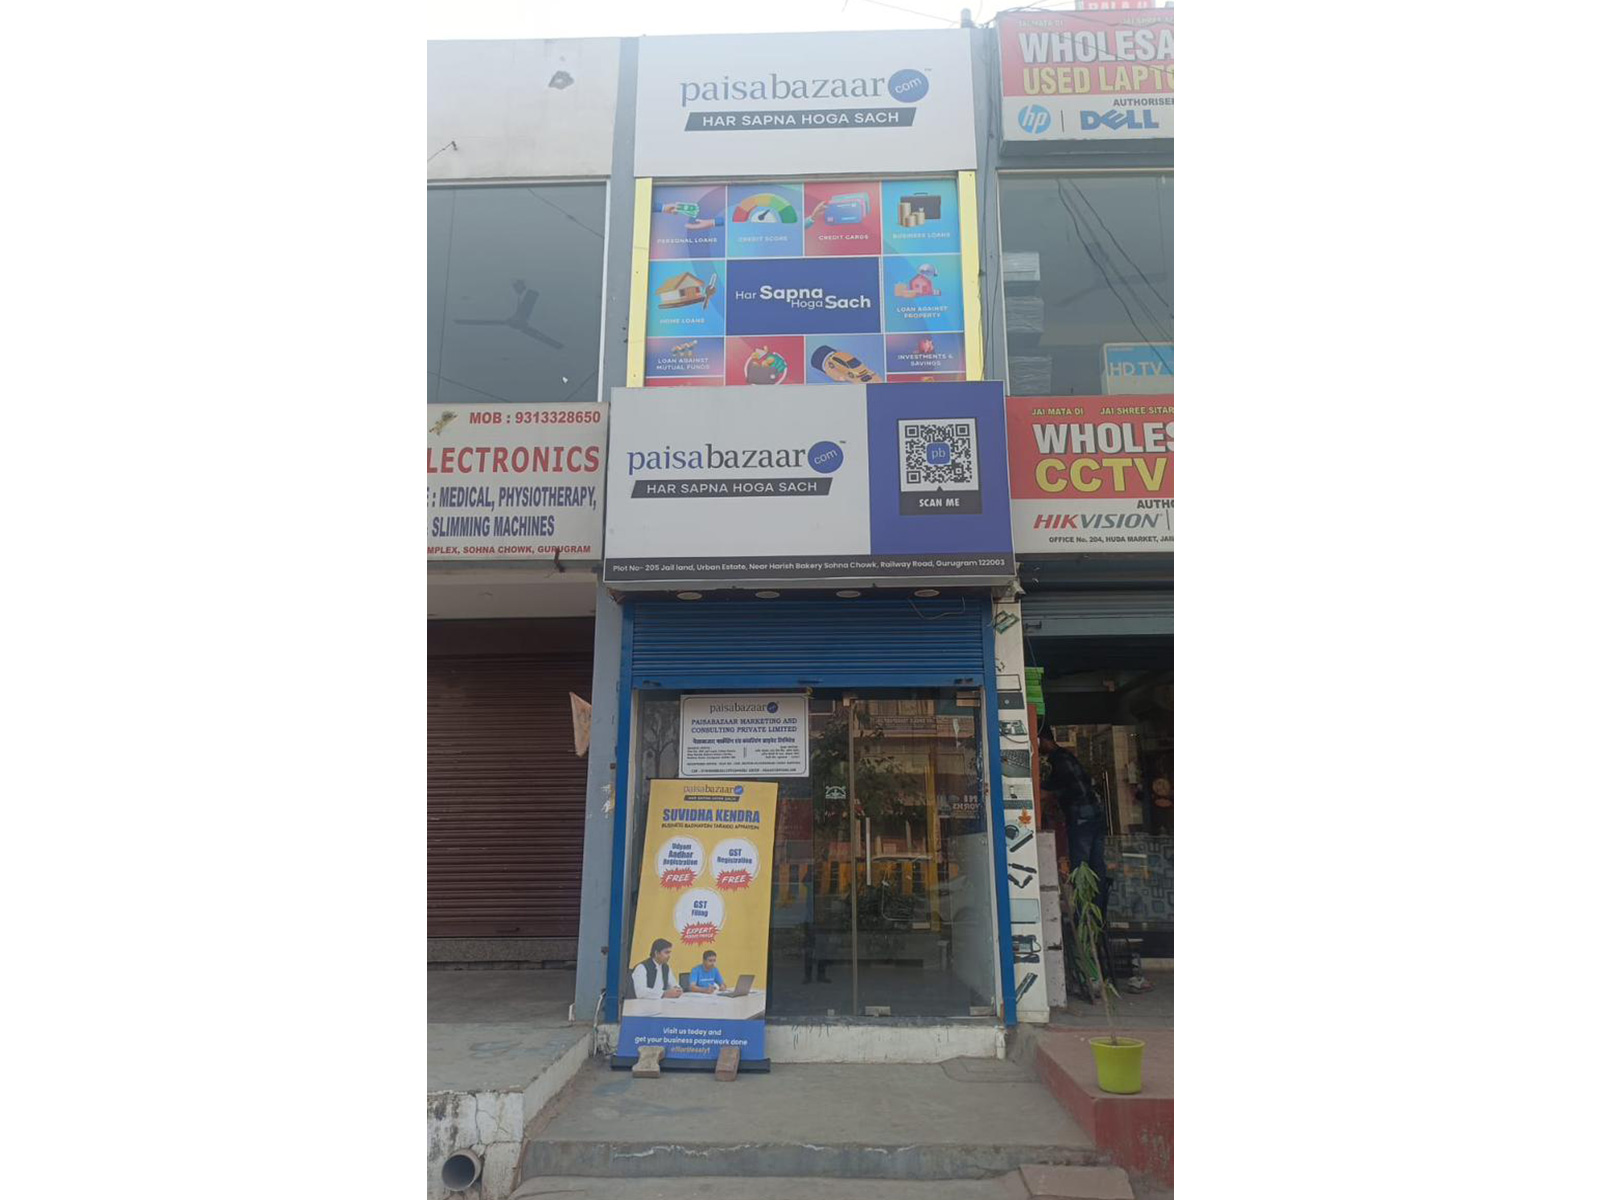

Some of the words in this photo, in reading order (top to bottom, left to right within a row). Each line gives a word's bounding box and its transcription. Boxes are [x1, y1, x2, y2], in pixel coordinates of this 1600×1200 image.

[894, 76, 922, 95] com
[1023, 66, 1090, 94] USED
[680, 73, 885, 107] paisabazaar
[703, 115, 736, 127] HAR
[741, 114, 796, 126] SAPNA
[802, 113, 849, 125] HOGA
[854, 112, 899, 124] SACH
[1022, 105, 1047, 133] hp
[1080, 109, 1159, 130] DELL
[735, 291, 757, 300] Har
[760, 285, 823, 302] Sapna
[791, 300, 823, 310] Hoga
[824, 295, 871, 310] Sach
[1110, 362, 1134, 376] HD
[1139, 361, 1162, 376] TV
[470, 412, 502, 424] MOB
[515, 411, 601, 424] 9313328650
[1032, 408, 1045, 416] JAI
[427, 446, 600, 474] LECTRONICS
[626, 444, 806, 476] paisabazaar
[814, 449, 838, 466] com
[932, 448, 946, 460] pb
[1035, 458, 1167, 492] CCTV
[647, 484, 676, 494] HAR
[680, 484, 728, 494] SAPNA
[733, 482, 774, 492] HOGA
[778, 482, 818, 492] SACH
[440, 486, 494, 511] MEDICAL,
[499, 486, 597, 510] PHYSIOTHERAPY,
[919, 498, 942, 507] SCAN
[946, 498, 960, 507] ME
[432, 516, 490, 537] SLIMMING
[494, 515, 555, 537] MACHINES
[1033, 513, 1159, 529] HIKVISION
[463, 546, 496, 554] SOHNA
[499, 546, 535, 554] CHOWK,
[613, 564, 628, 572] Plot
[722, 563, 748, 571] Estate,
[769, 562, 794, 570] Harish
[796, 562, 822, 570] Bakery
[850, 562, 879, 570] Chowk,
[880, 561, 911, 570] Railway
[912, 560, 934, 568] Road,
[936, 560, 978, 569] Gurugram
[710, 702, 766, 714] paisabazaar
[684, 785, 734, 794] paisabazaar
[662, 808, 713, 822] SUVIDHA
[716, 809, 760, 823] KENDRA
[672, 843, 692, 851] Udyam
[729, 849, 742, 857] GST
[662, 858, 698, 866] Registration
[665, 874, 690, 882] FREE
[722, 875, 746, 884] FREE
[694, 900, 707, 908] GST
[688, 1028, 707, 1036] today
[634, 1036, 646, 1044] get
[694, 1038, 729, 1046] paperwork
